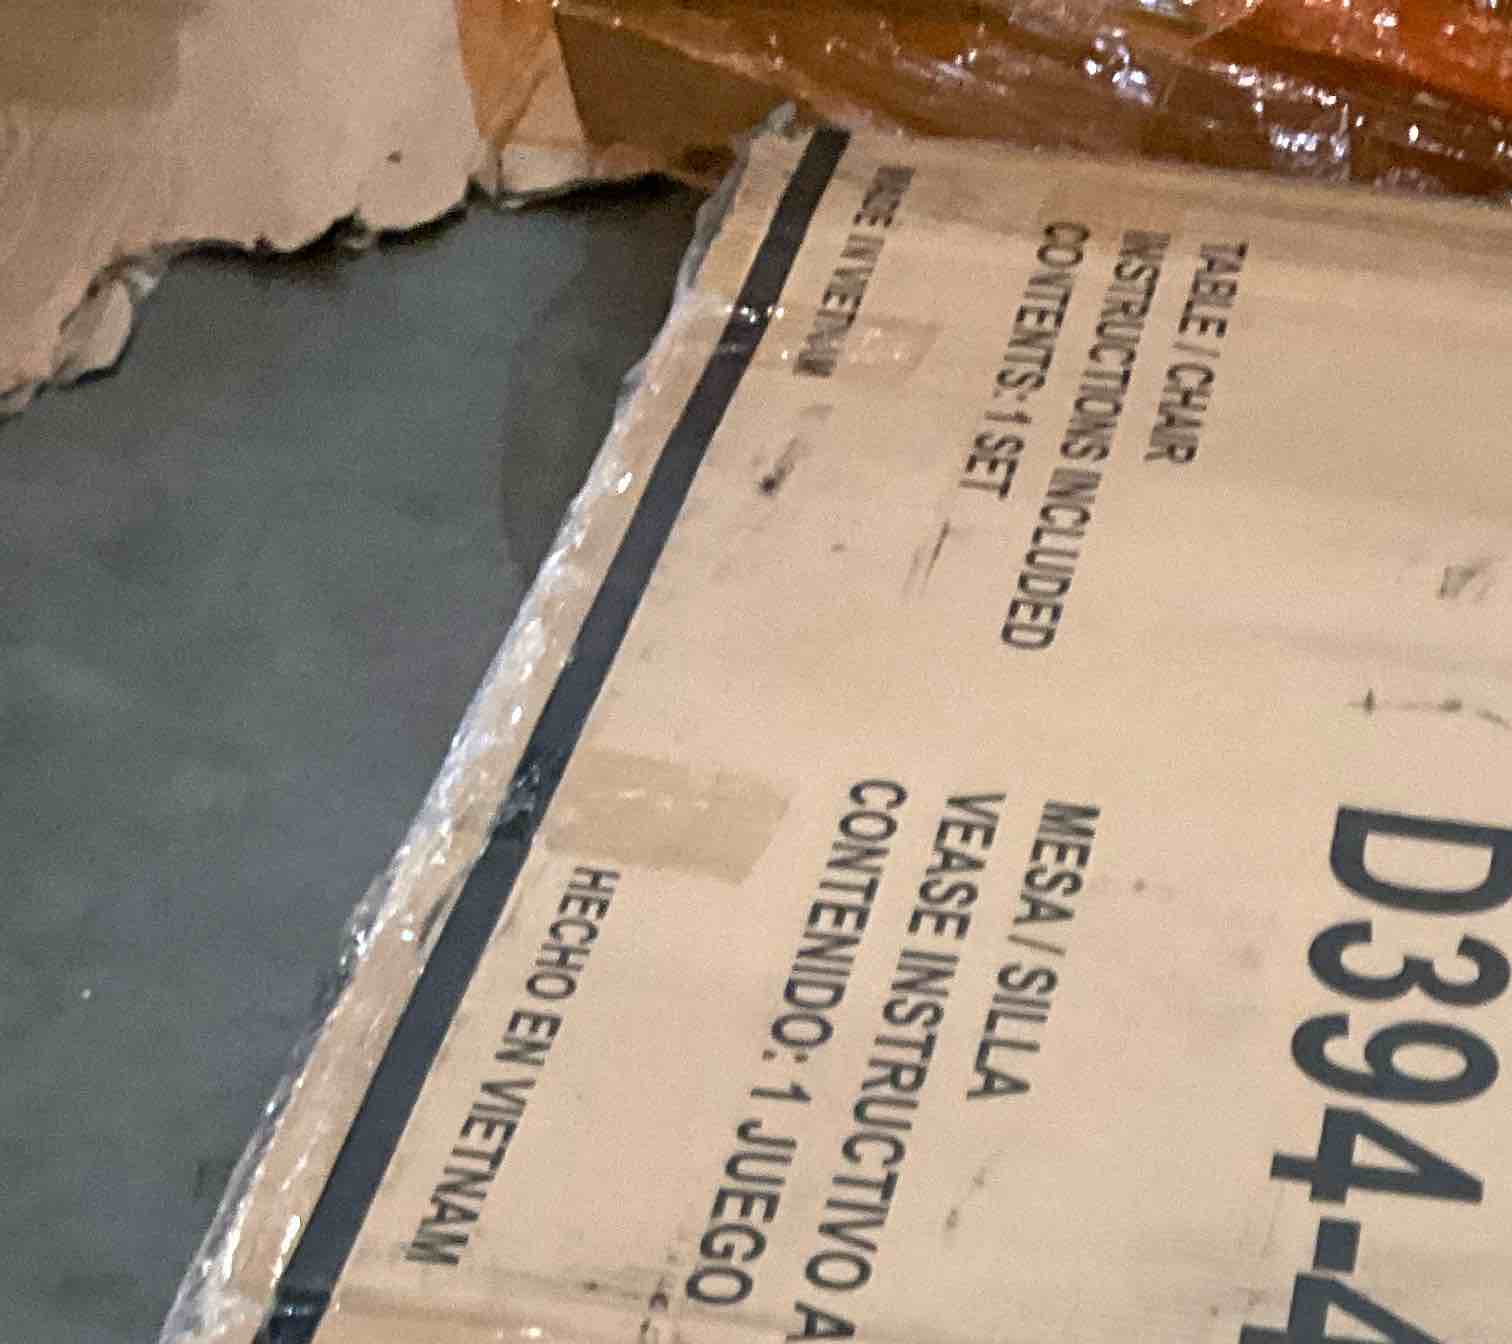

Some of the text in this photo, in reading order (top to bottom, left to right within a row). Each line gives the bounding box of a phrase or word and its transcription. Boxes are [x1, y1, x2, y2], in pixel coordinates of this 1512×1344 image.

[1178, 239, 1249, 338] TABLE
[959, 430, 1025, 500] SET
[1001, 230, 1171, 651] INSTRUCTIONS INCLUDED
[1144, 361, 1216, 465] CHAIR
[762, 778, 908, 1064] CONTENIDO:
[908, 791, 1007, 939] VEASE
[1014, 800, 1101, 925] MESA
[402, 865, 622, 1268] HECHO EN VIETNAM
[967, 962, 1058, 1101] SILLA
[805, 947, 960, 1292] INSTRUCTIVO
[685, 1119, 798, 1308] JUEGO
